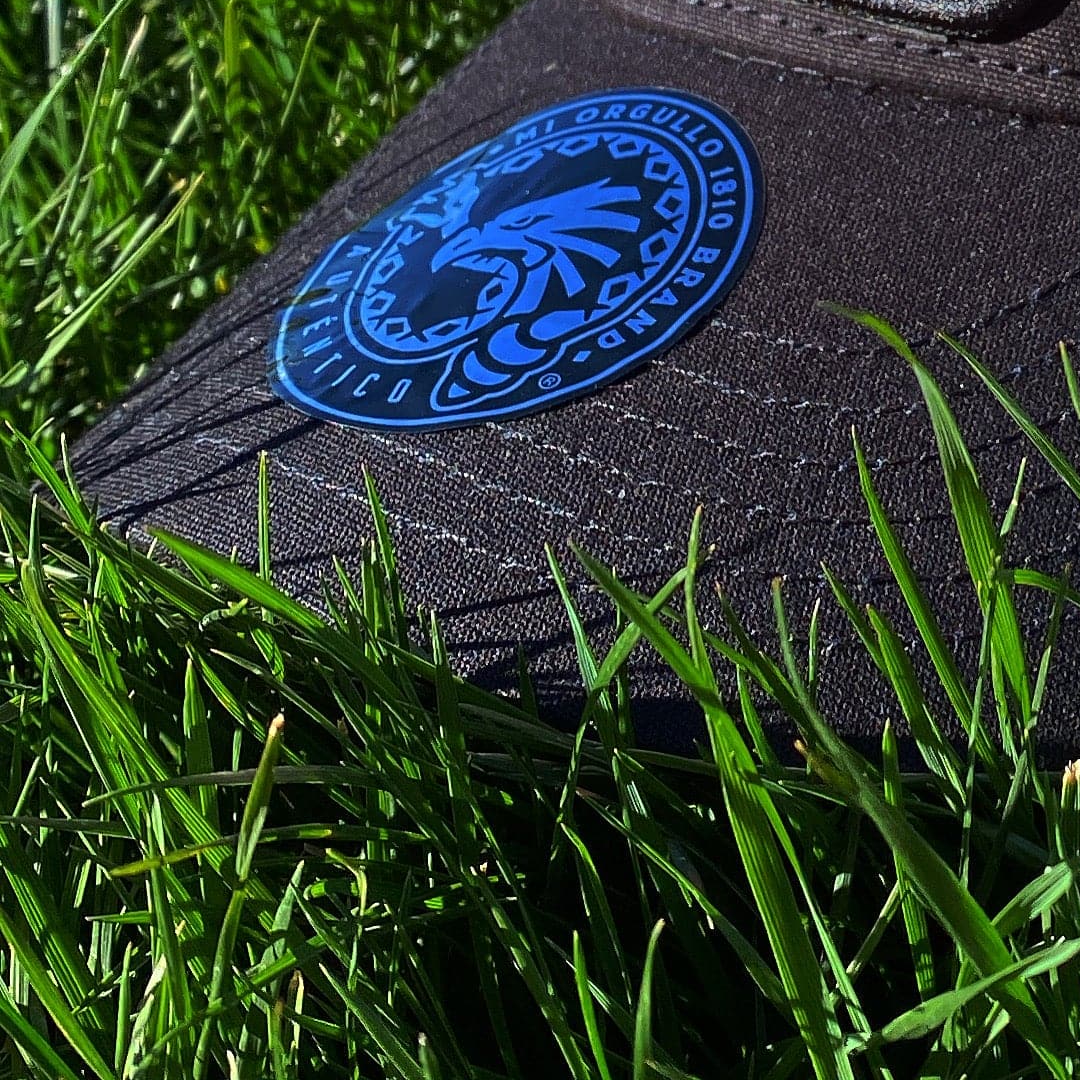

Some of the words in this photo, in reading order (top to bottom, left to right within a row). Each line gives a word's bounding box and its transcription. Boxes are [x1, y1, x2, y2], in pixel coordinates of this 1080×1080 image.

[515, 119, 555, 146] MI
[576, 103, 724, 158] ORGULLO
[709, 166, 738, 230] 1810
[598, 246, 721, 349] BRAND
